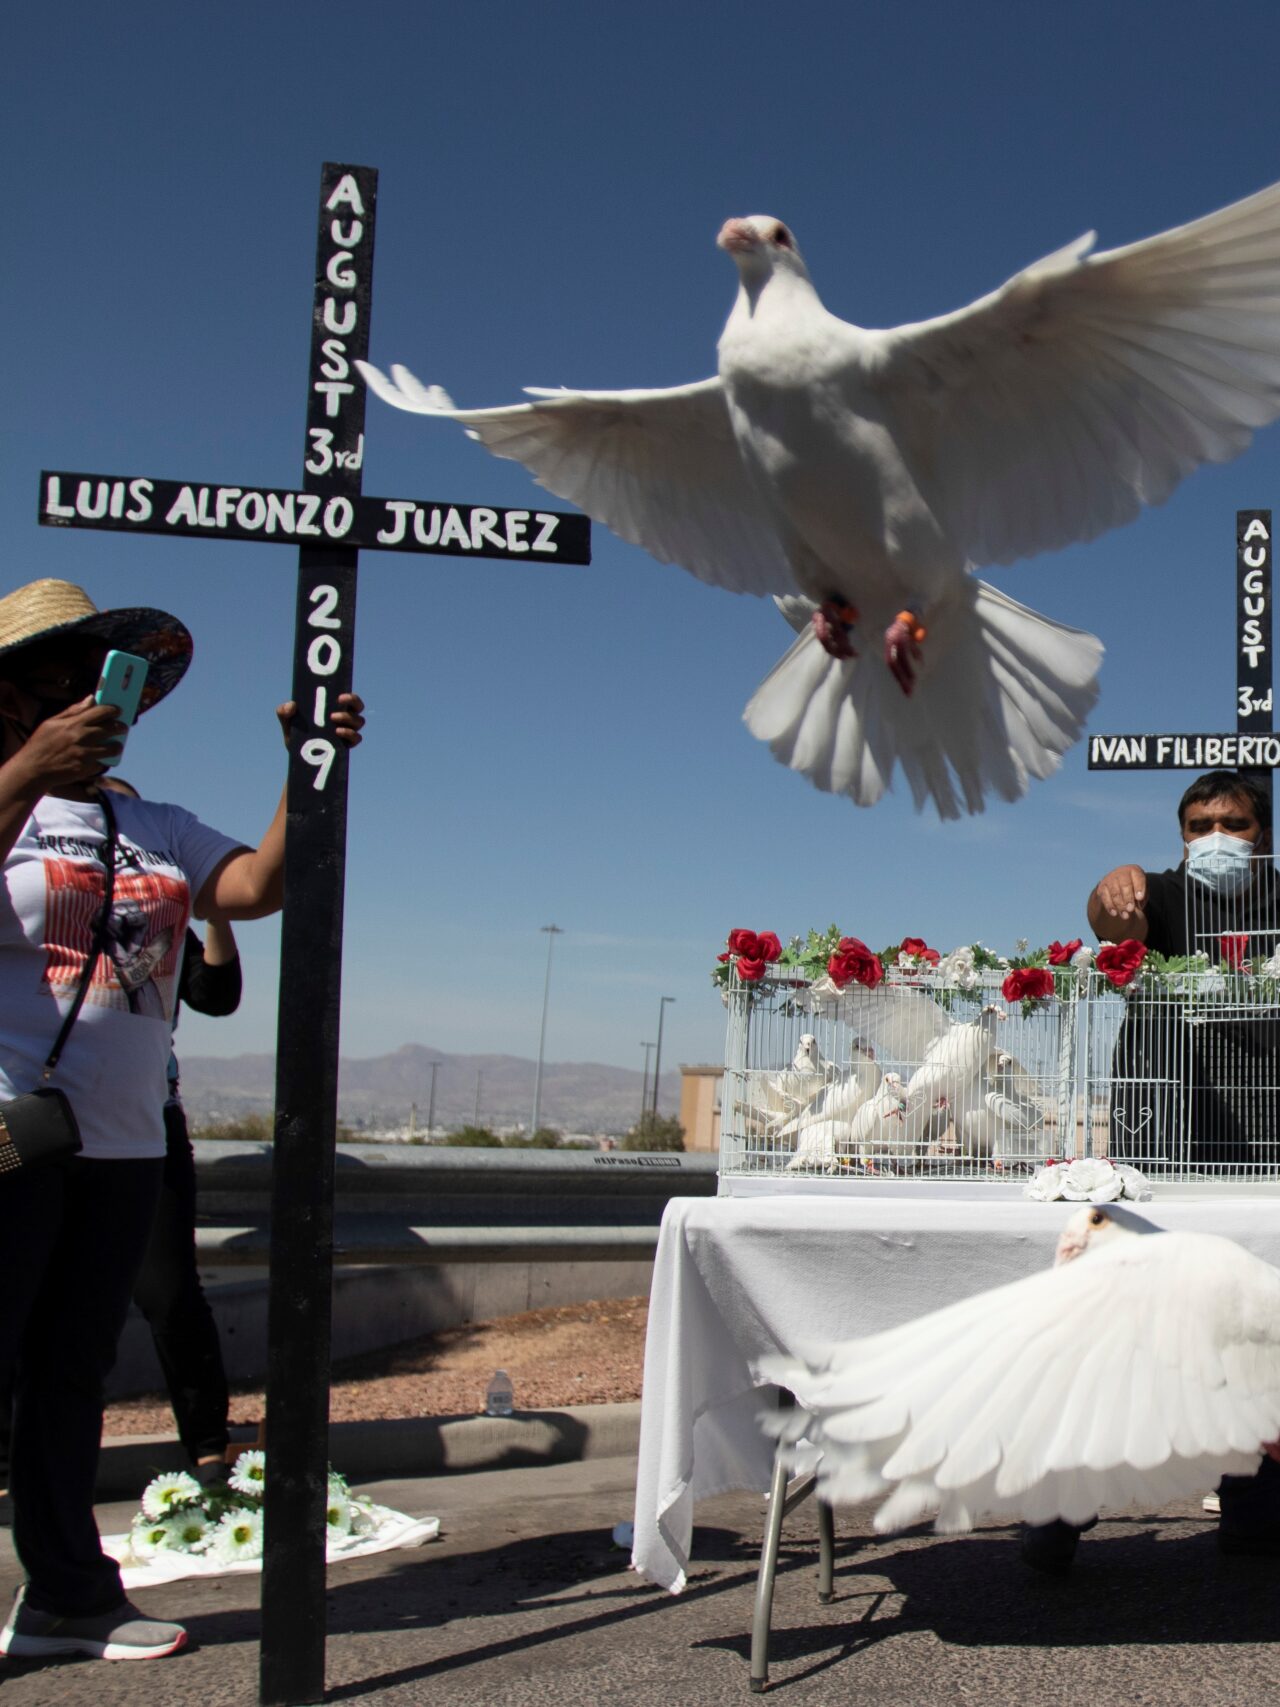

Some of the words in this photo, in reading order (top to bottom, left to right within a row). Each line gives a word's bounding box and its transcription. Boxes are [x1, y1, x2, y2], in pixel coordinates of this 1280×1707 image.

[314, 174, 365, 417] AUGUST
[305, 427, 365, 475] 3rd
[46, 476, 154, 523] LUIS
[165, 485, 354, 539] ALFONZO
[376, 501, 560, 553] JUAREZ
[1242, 519, 1270, 669] AUGUST
[301, 584, 342, 792] 2019
[1237, 686, 1273, 718] 3rd
[1091, 735, 1147, 764] IVAN
